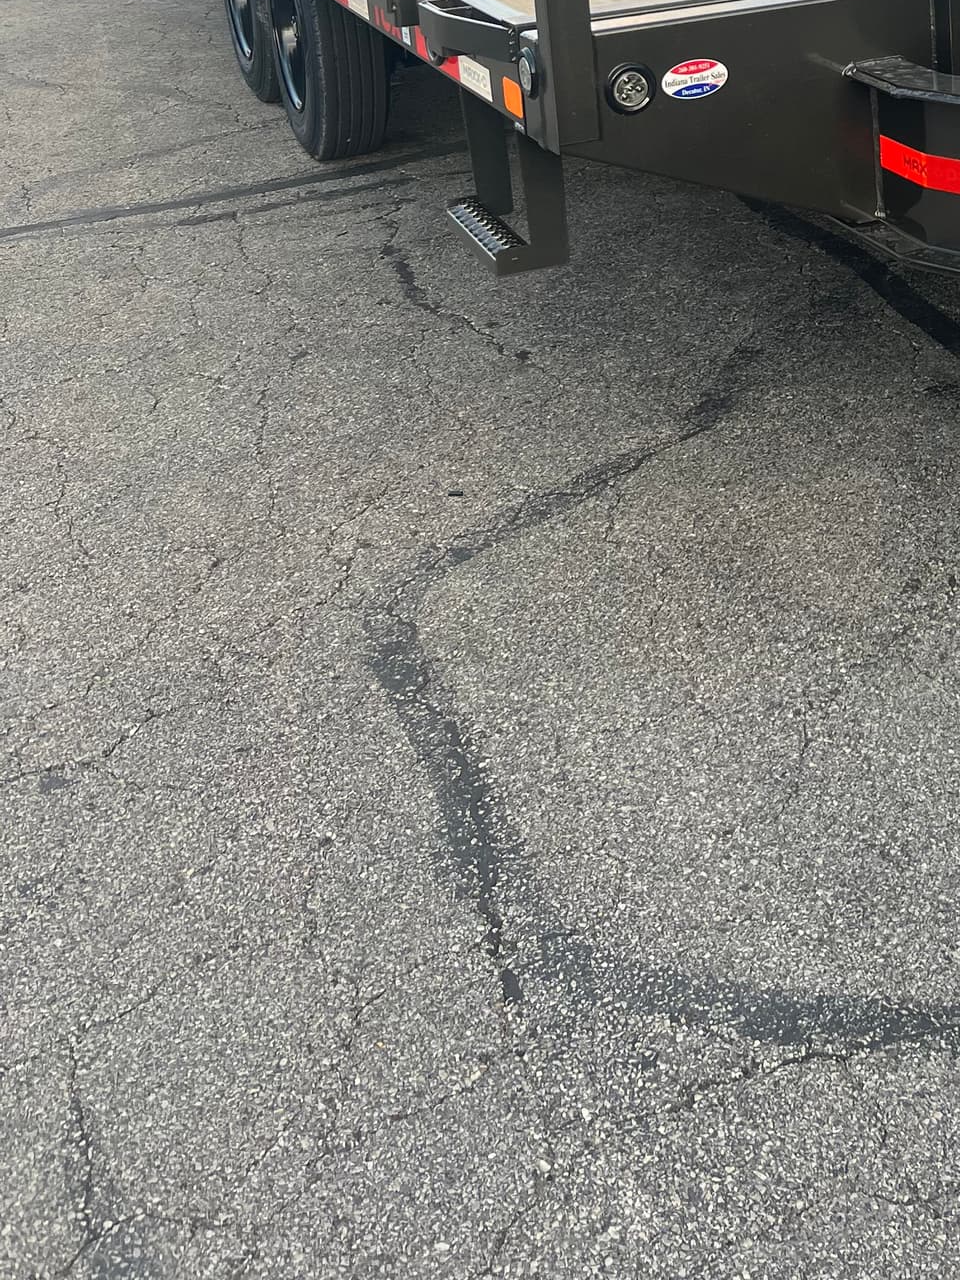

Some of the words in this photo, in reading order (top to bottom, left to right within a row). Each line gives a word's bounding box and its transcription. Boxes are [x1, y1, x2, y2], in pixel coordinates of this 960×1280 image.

[664, 78, 688, 88] Indiana
[690, 74, 709, 83] Trailer
[710, 71, 726, 80] Sales
